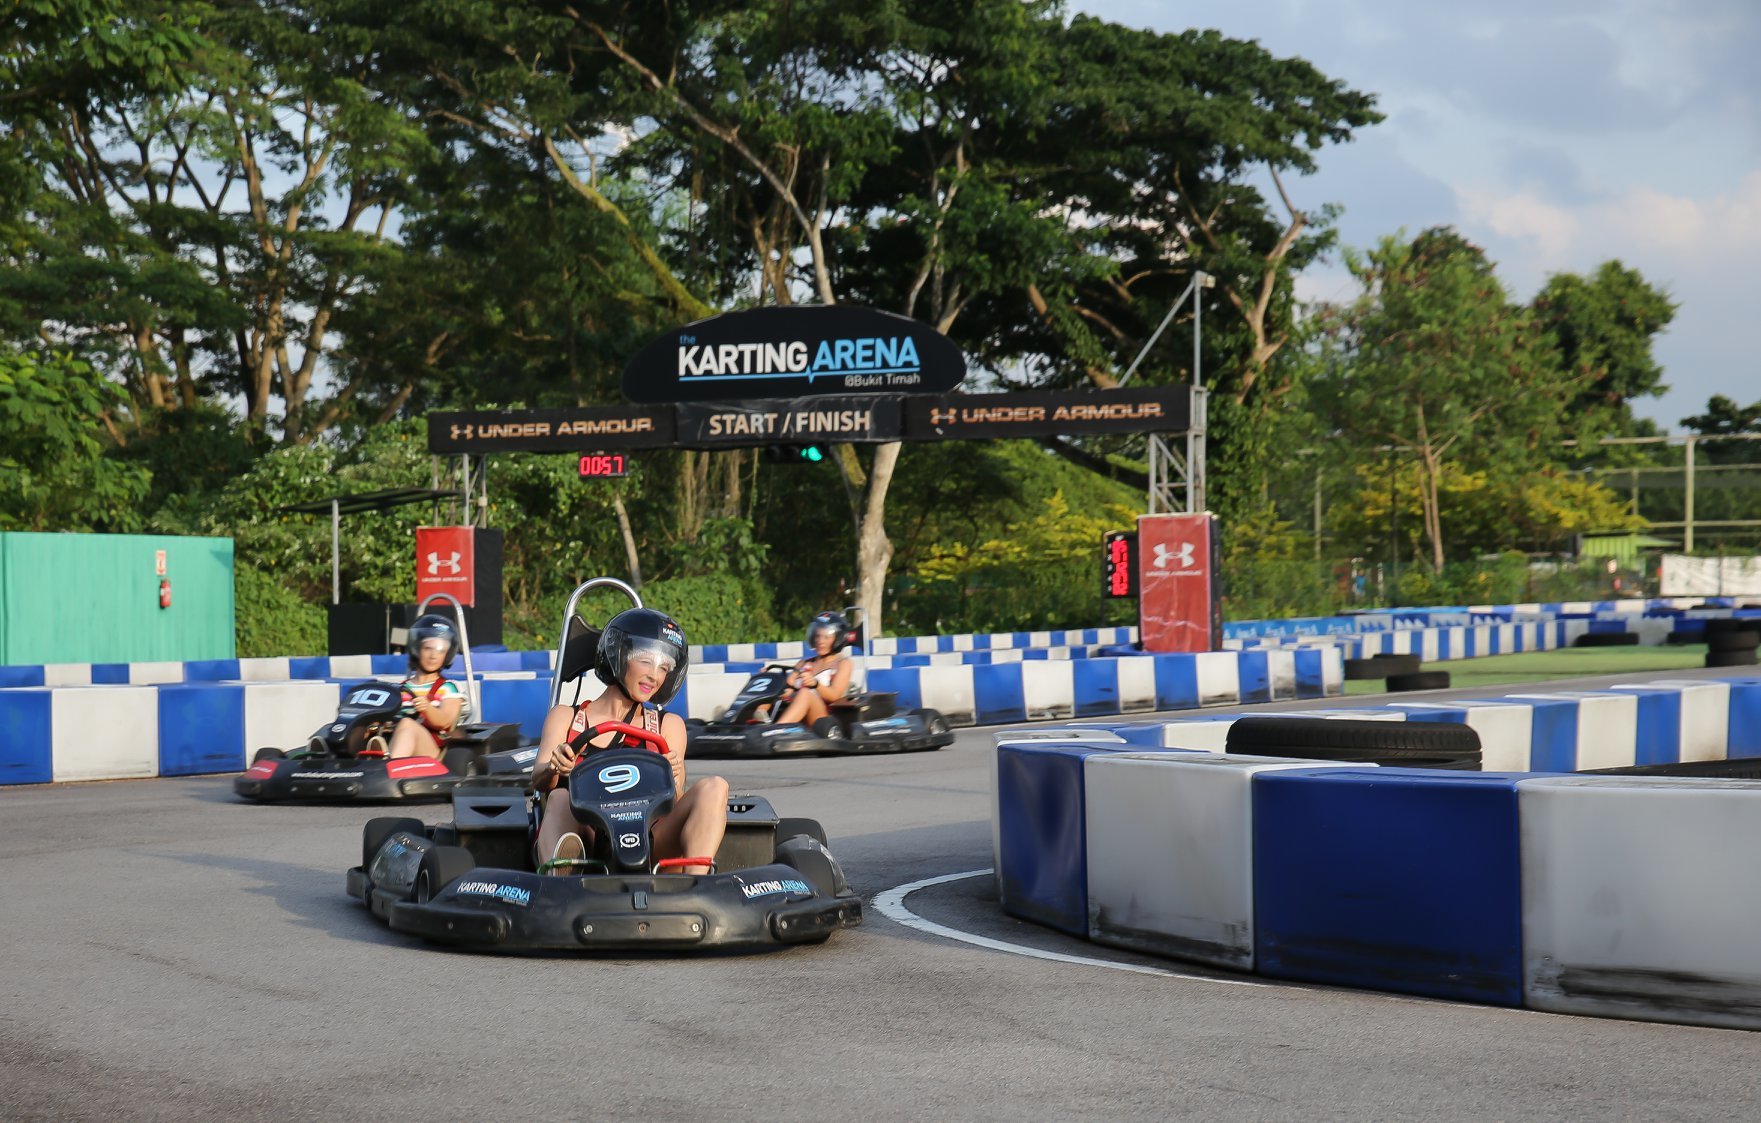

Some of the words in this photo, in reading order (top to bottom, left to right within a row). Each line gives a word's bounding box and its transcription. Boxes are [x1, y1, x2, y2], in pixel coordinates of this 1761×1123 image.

[679, 335, 696, 345] the
[678, 341, 808, 376] KARTING
[813, 336, 920, 370] ARENA
[709, 413, 778, 435] START
[796, 410, 871, 433] FINISH
[962, 407, 1046, 423] UNDER
[478, 422, 551, 438] UNDER
[580, 456, 623, 475] 0057
[747, 678, 773, 692] 2
[349, 689, 391, 707] 10
[598, 764, 641, 793] 9
[456, 881, 498, 894] KARTING
[495, 885, 532, 902] ARENA
[741, 880, 782, 898] KARTING
[781, 879, 810, 892] ARENA
